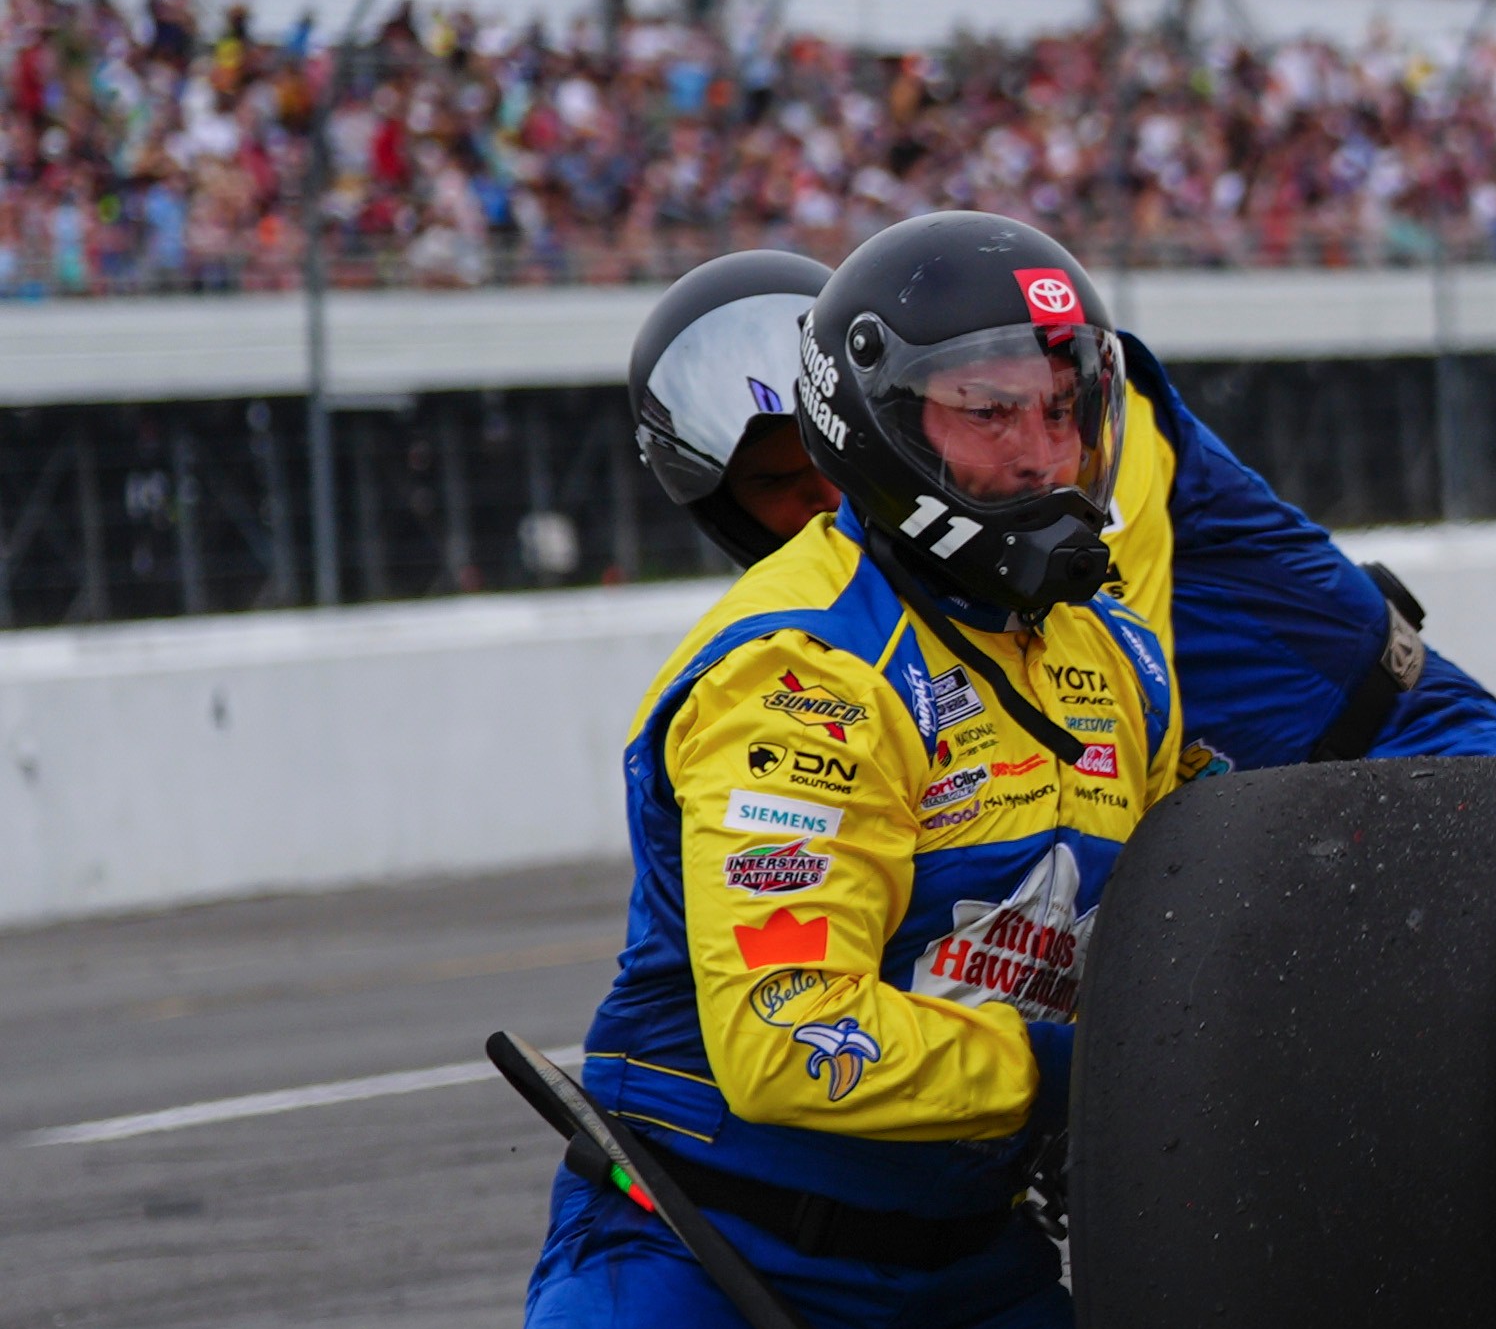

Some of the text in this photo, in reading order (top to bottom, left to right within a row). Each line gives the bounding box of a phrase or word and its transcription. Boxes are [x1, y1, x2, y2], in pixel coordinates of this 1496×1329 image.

[900, 495, 983, 560] 11
[768, 690, 861, 723] SUNOCO
[793, 750, 858, 782] DN
[788, 774, 852, 795] SOLUTIONS
[739, 803, 827, 834] SIEMENS
[727, 857, 827, 872] INTERSTATE
[730, 871, 821, 885] BATTERIES
